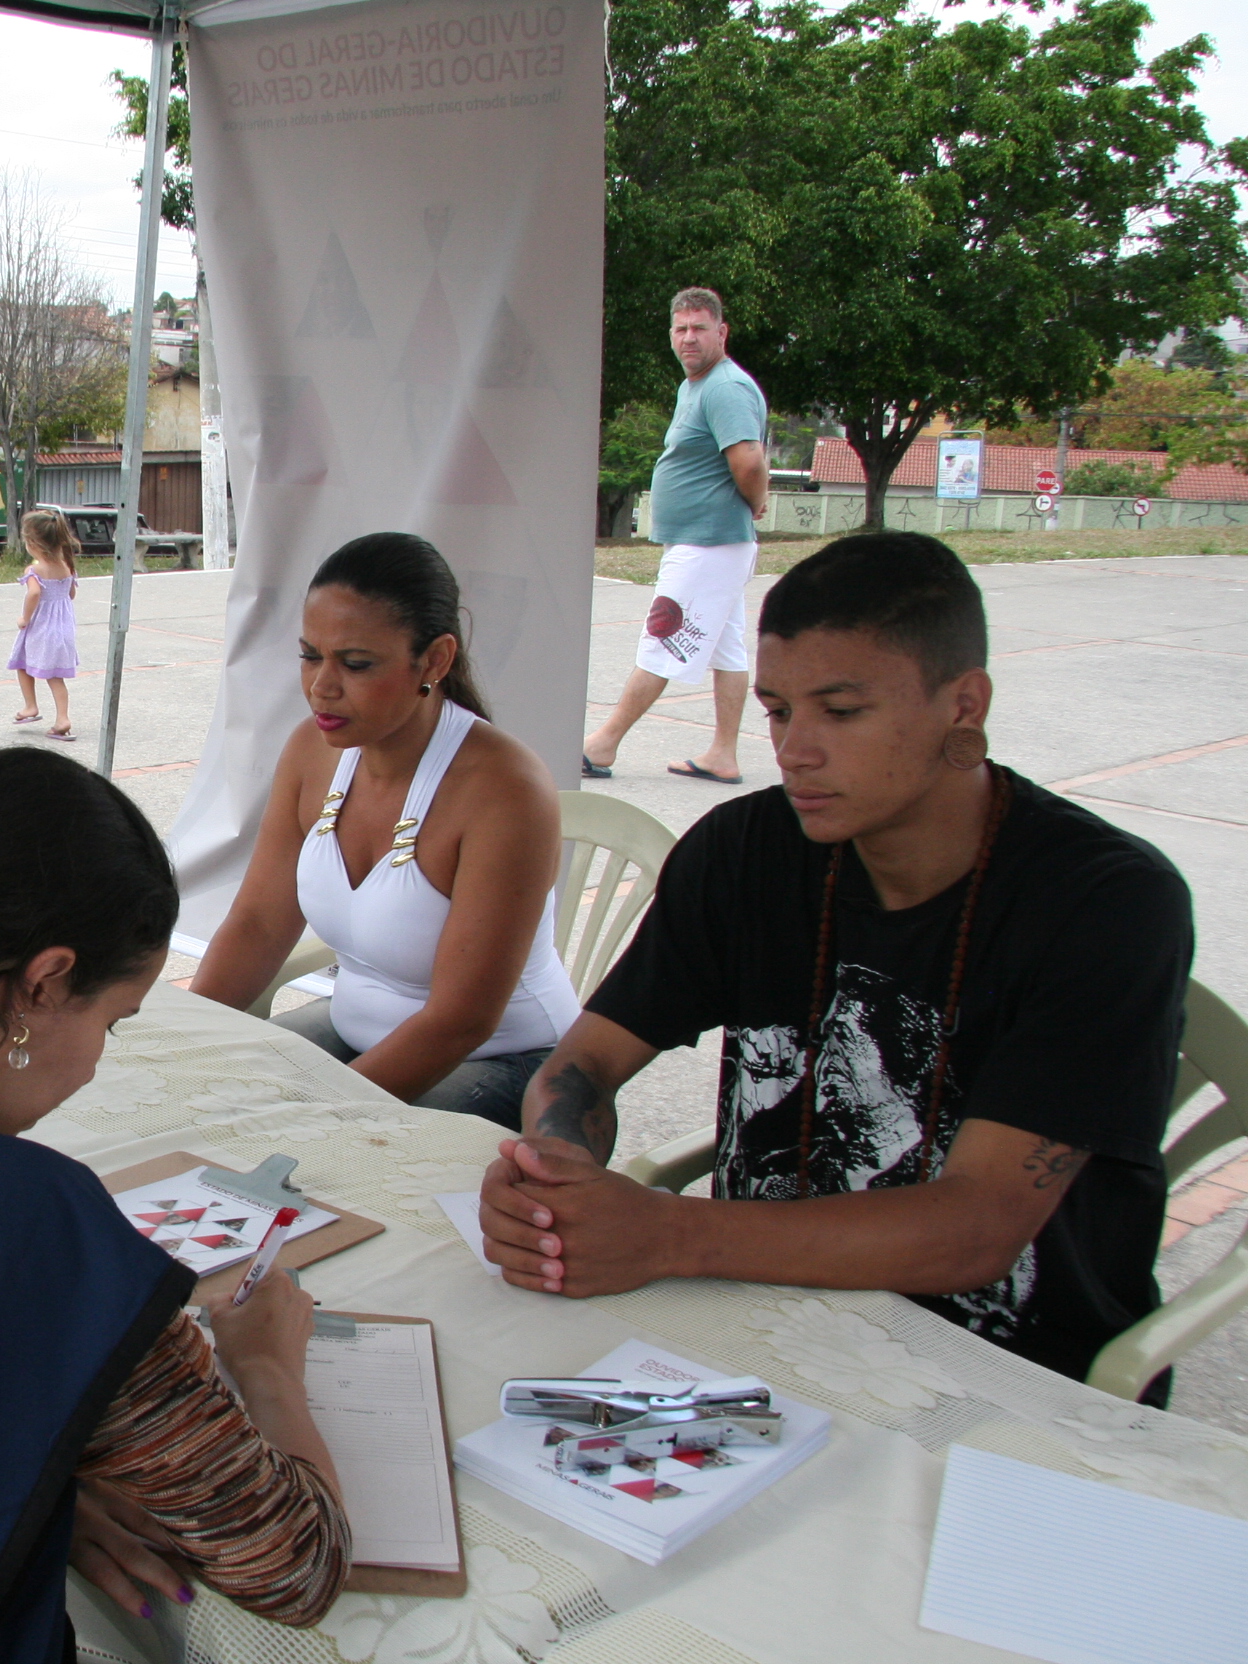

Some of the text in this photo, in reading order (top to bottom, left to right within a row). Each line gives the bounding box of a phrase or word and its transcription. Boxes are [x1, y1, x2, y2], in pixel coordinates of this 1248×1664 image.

[1036, 477, 1057, 485] PARE
[682, 618, 710, 642] SURF
[200, 1181, 234, 1197] ESTADO
[535, 1463, 616, 1501] MINAS GERAIS
